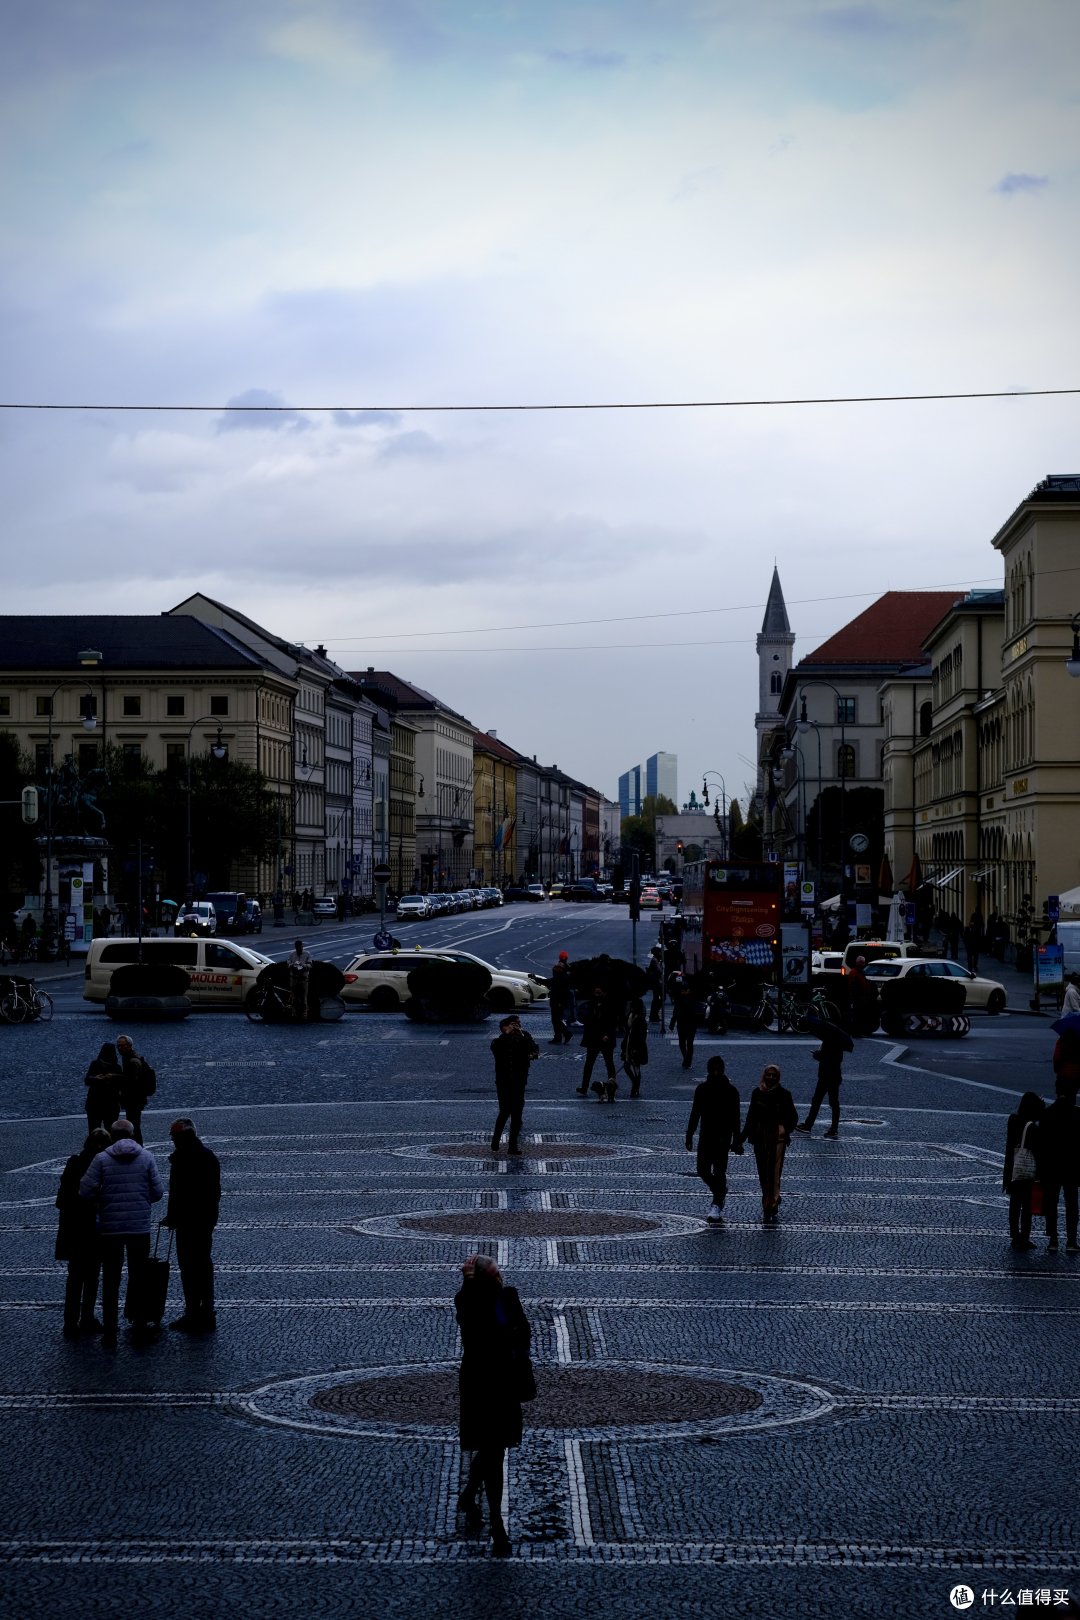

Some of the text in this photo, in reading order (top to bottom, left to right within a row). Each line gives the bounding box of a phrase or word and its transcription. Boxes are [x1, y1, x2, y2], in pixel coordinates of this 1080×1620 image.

[354, 854, 361, 863] U
[769, 852, 777, 862] U
[191, 973, 227, 983] MÜLLER
